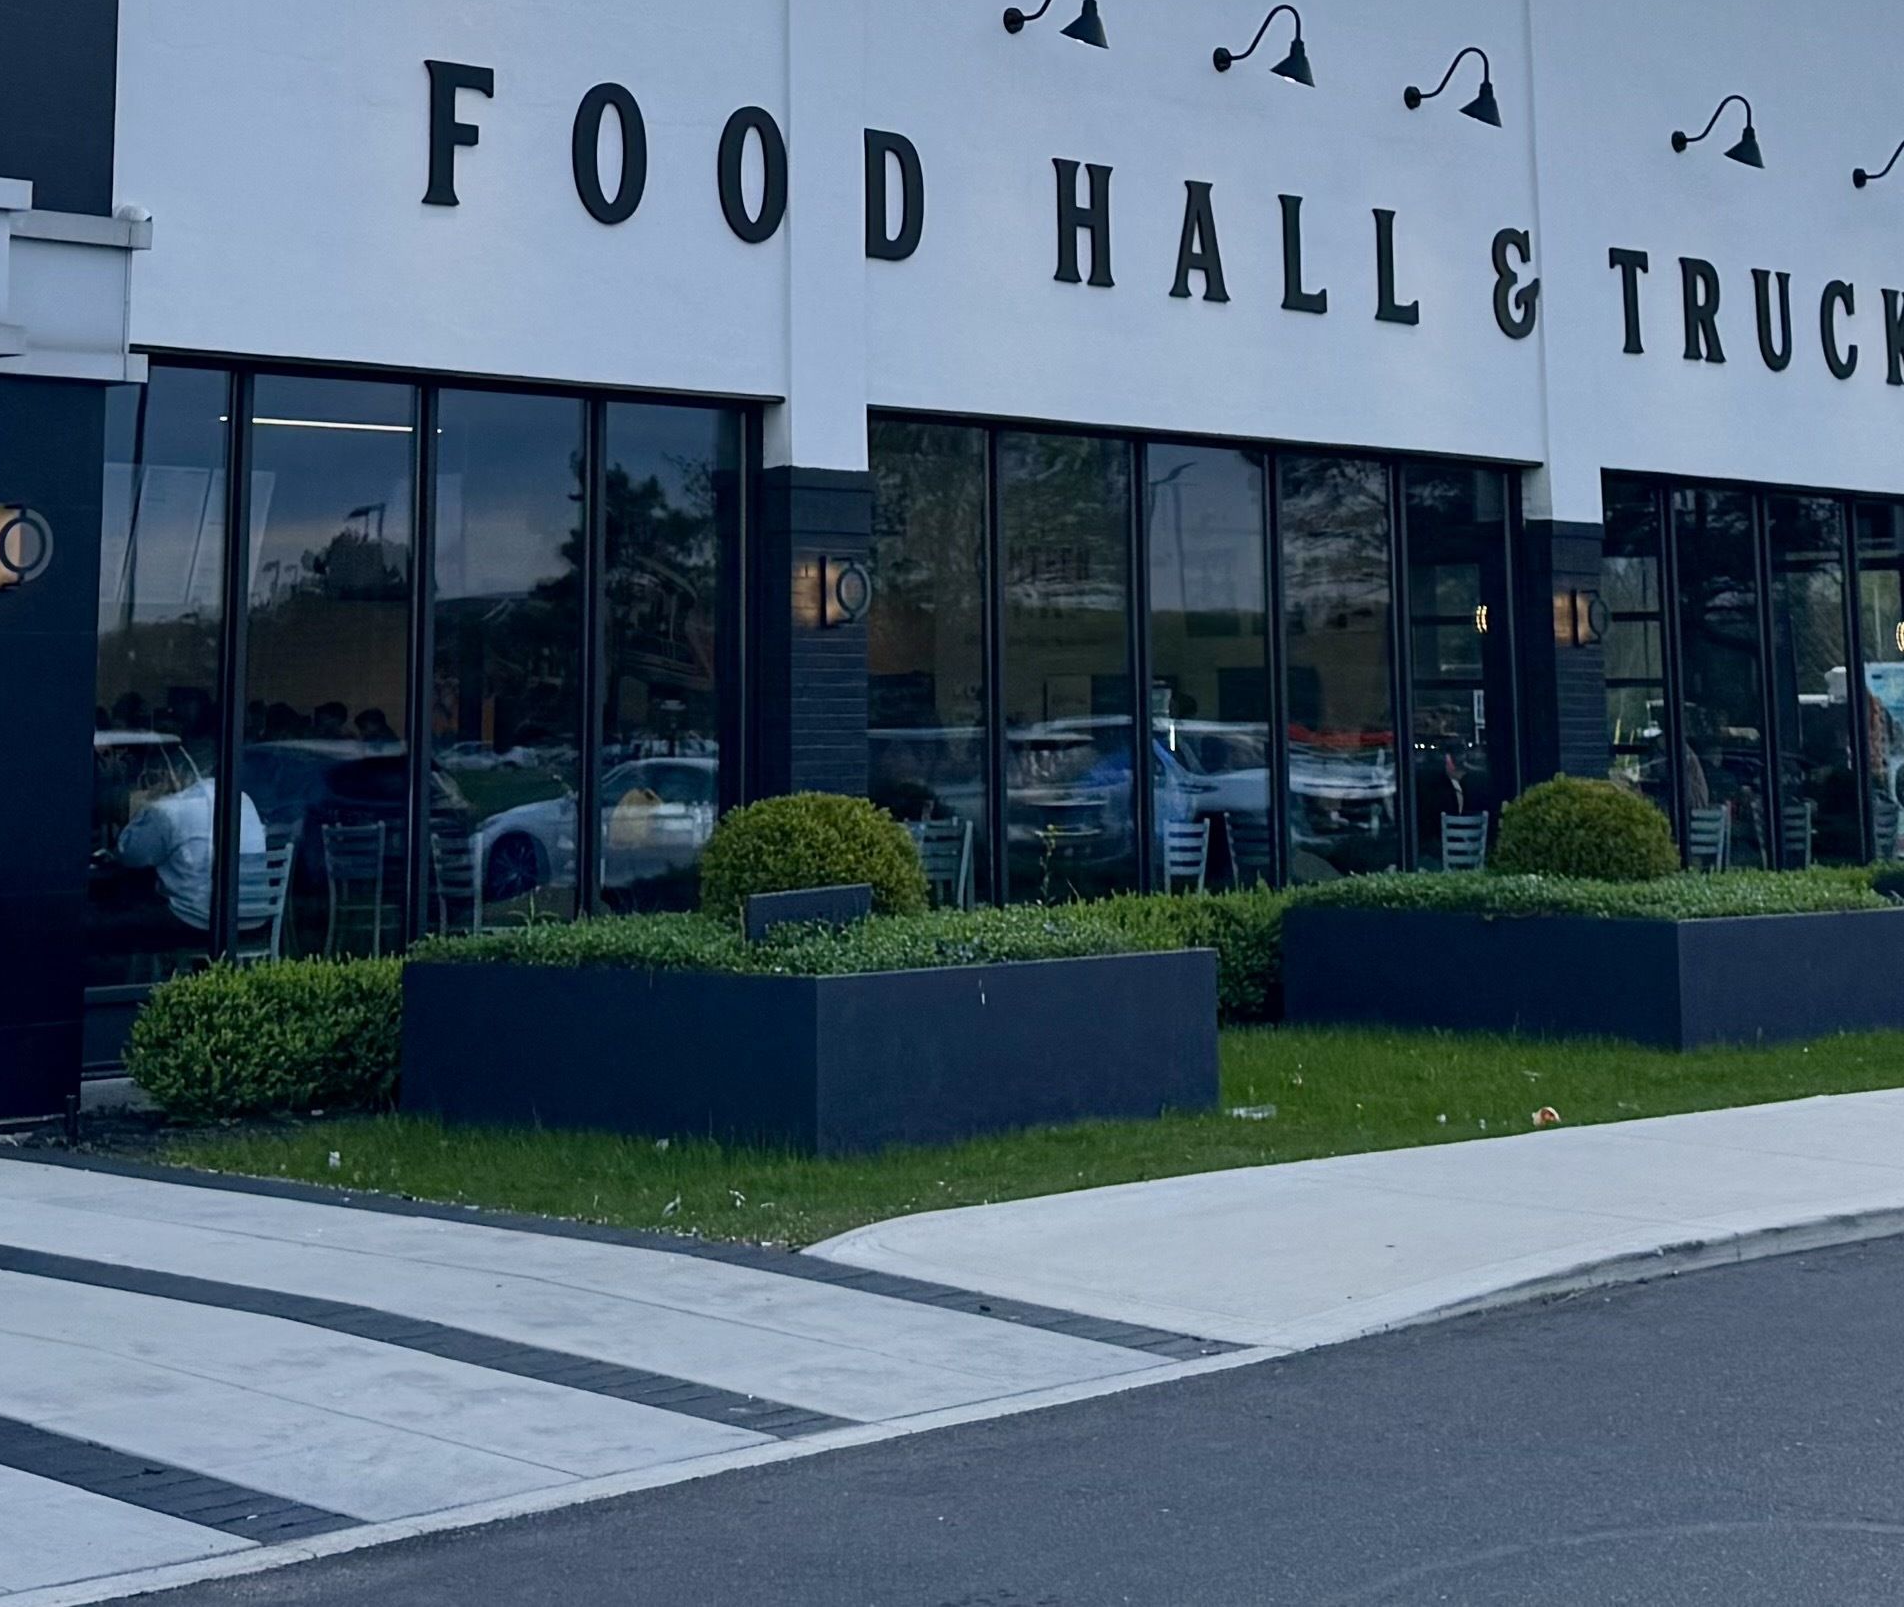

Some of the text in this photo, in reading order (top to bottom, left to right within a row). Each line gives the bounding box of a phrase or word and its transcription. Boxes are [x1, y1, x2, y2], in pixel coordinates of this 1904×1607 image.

[422, 59, 925, 261] FOOD
[1052, 157, 1420, 325] HALL
[1491, 227, 1540, 339] &
